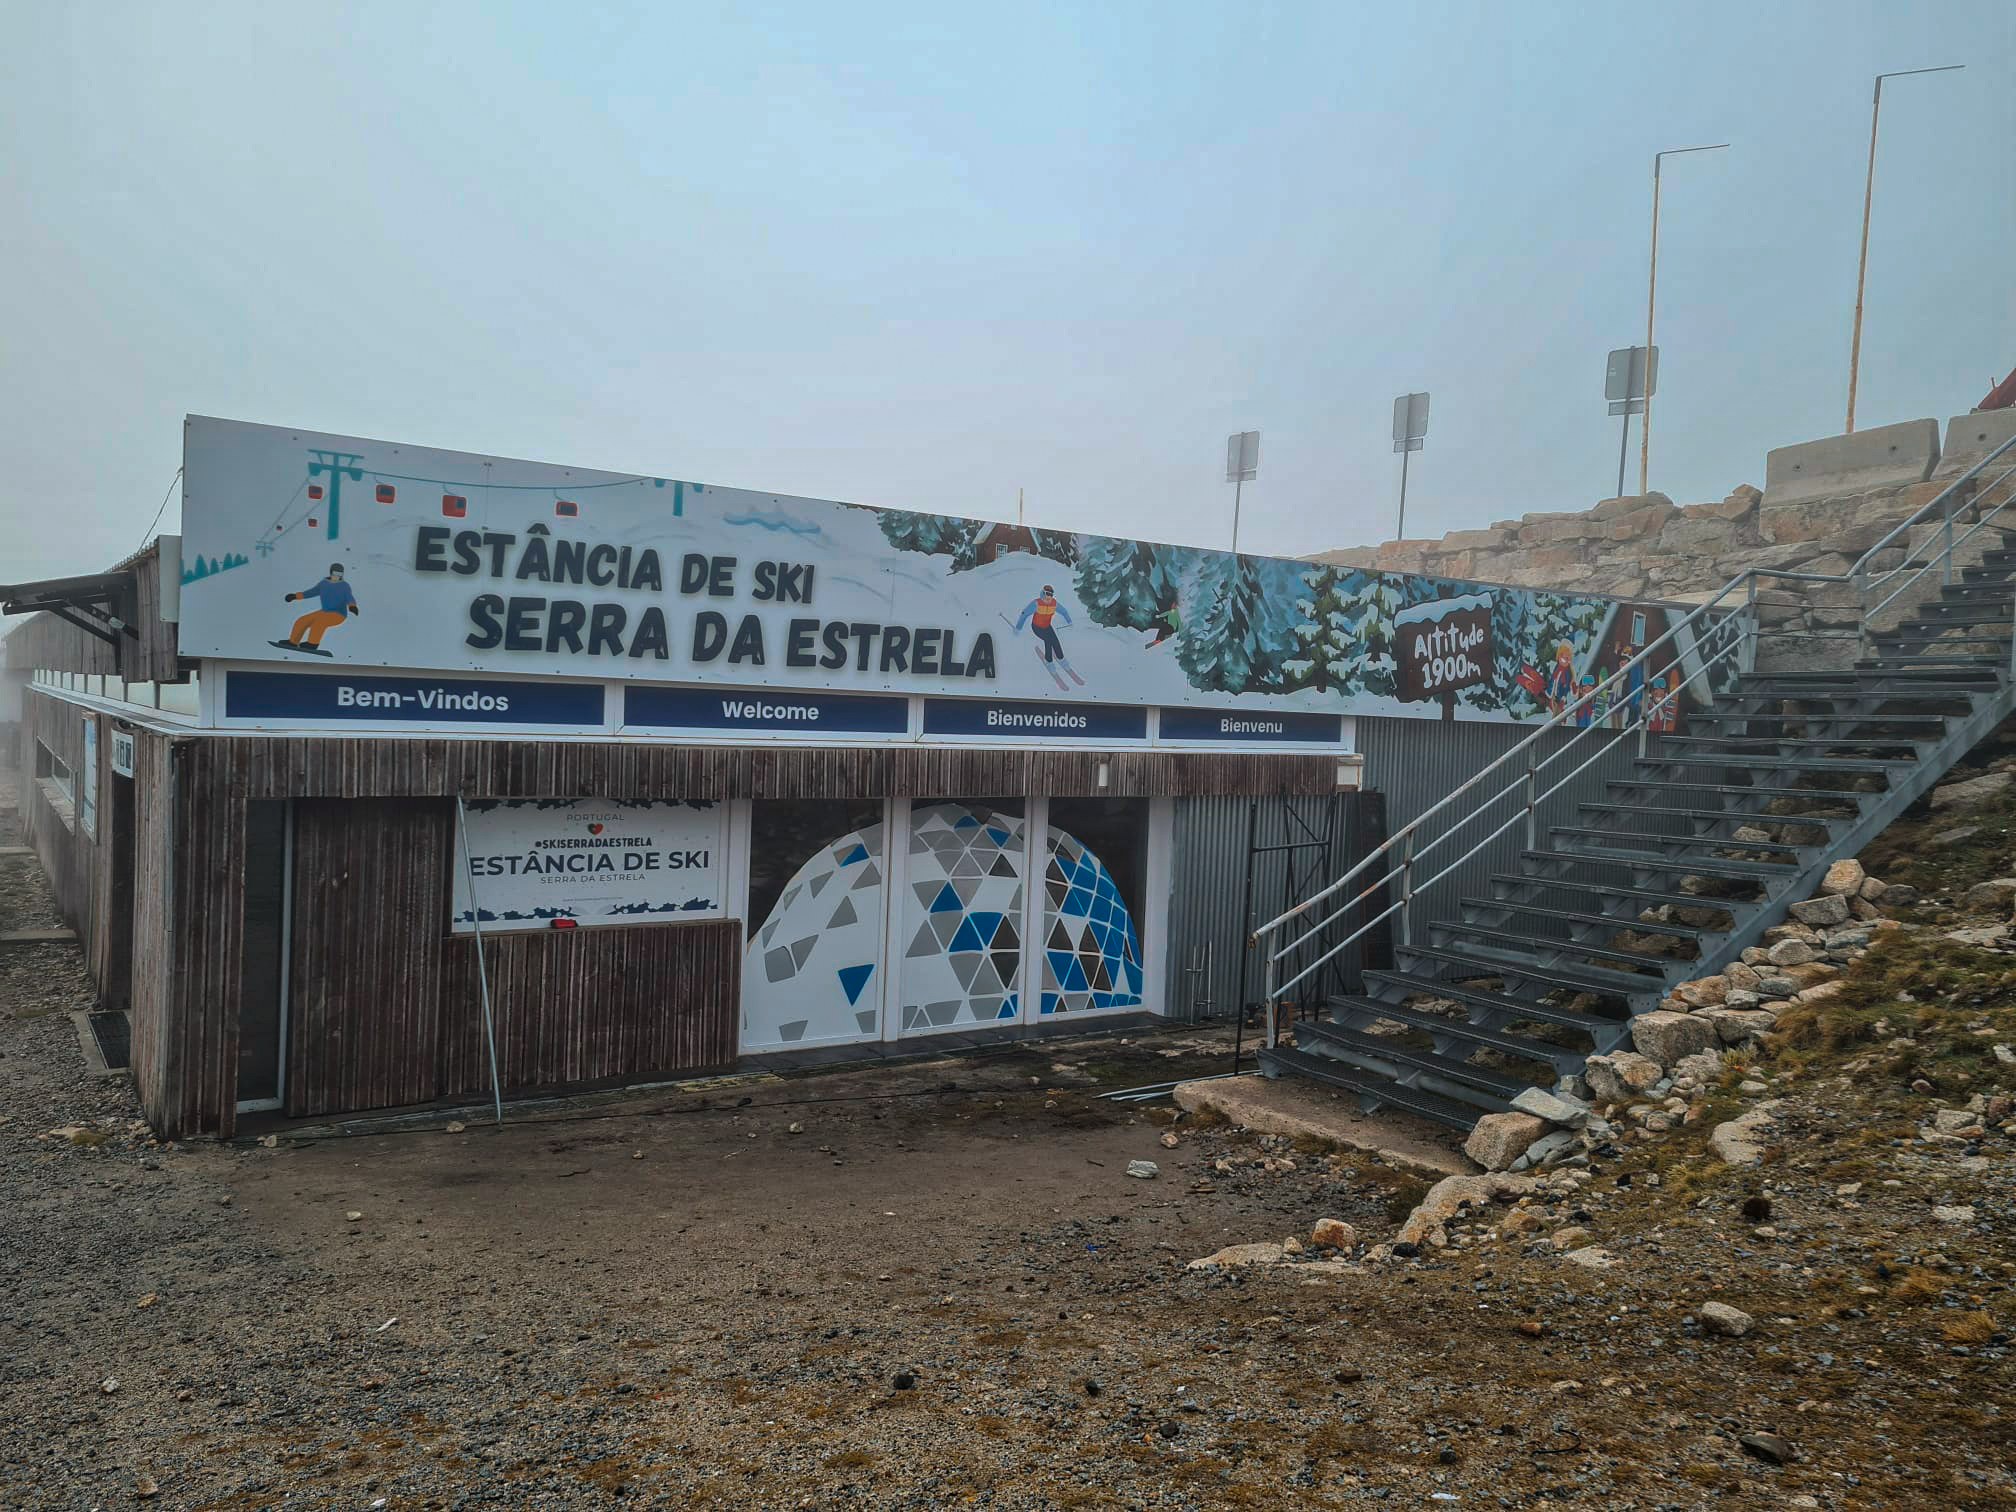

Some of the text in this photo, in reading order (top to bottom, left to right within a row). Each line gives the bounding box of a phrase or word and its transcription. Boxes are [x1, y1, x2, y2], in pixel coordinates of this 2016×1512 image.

[415, 522, 815, 604] ESTÂNCIA DE SKI
[465, 593, 996, 679] SERRA DA ESTRELA
[1414, 622, 1484, 659] Altitude
[1422, 655, 1480, 689] 1900m
[337, 686, 509, 712] Bem-Vindos
[722, 700, 819, 721] Welcome
[987, 710, 1087, 729] Bienvenidos
[1220, 718, 1283, 734] Bienvenu
[566, 813, 625, 822] PORTUGAL
[470, 850, 709, 876] ESTÂNCIA DE SKI
[540, 873, 646, 885] SERRA DA ESTRELA
